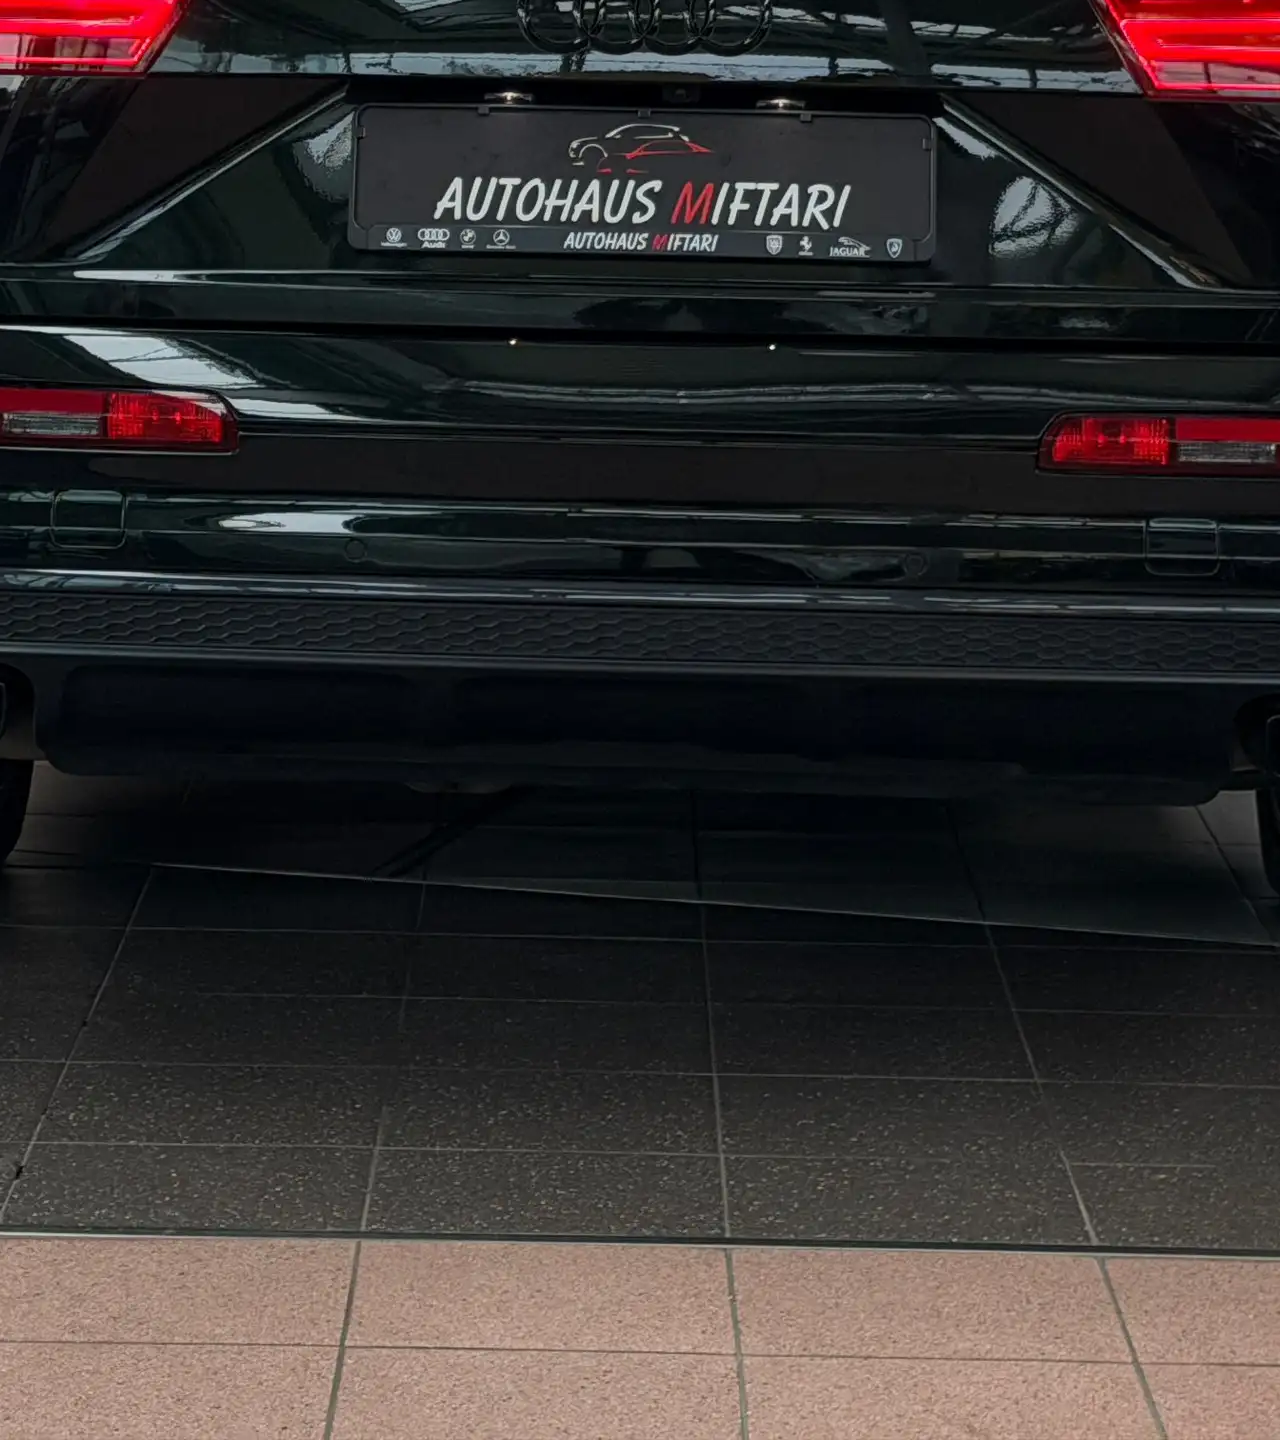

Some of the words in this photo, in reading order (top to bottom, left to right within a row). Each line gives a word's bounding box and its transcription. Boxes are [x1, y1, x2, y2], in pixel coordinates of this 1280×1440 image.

[433, 176, 662, 225] AUTOHAUS
[671, 181, 851, 231] MIFTARI
[563, 232, 649, 250] AUTOHAUS
[651, 233, 719, 252] MIFTARI
